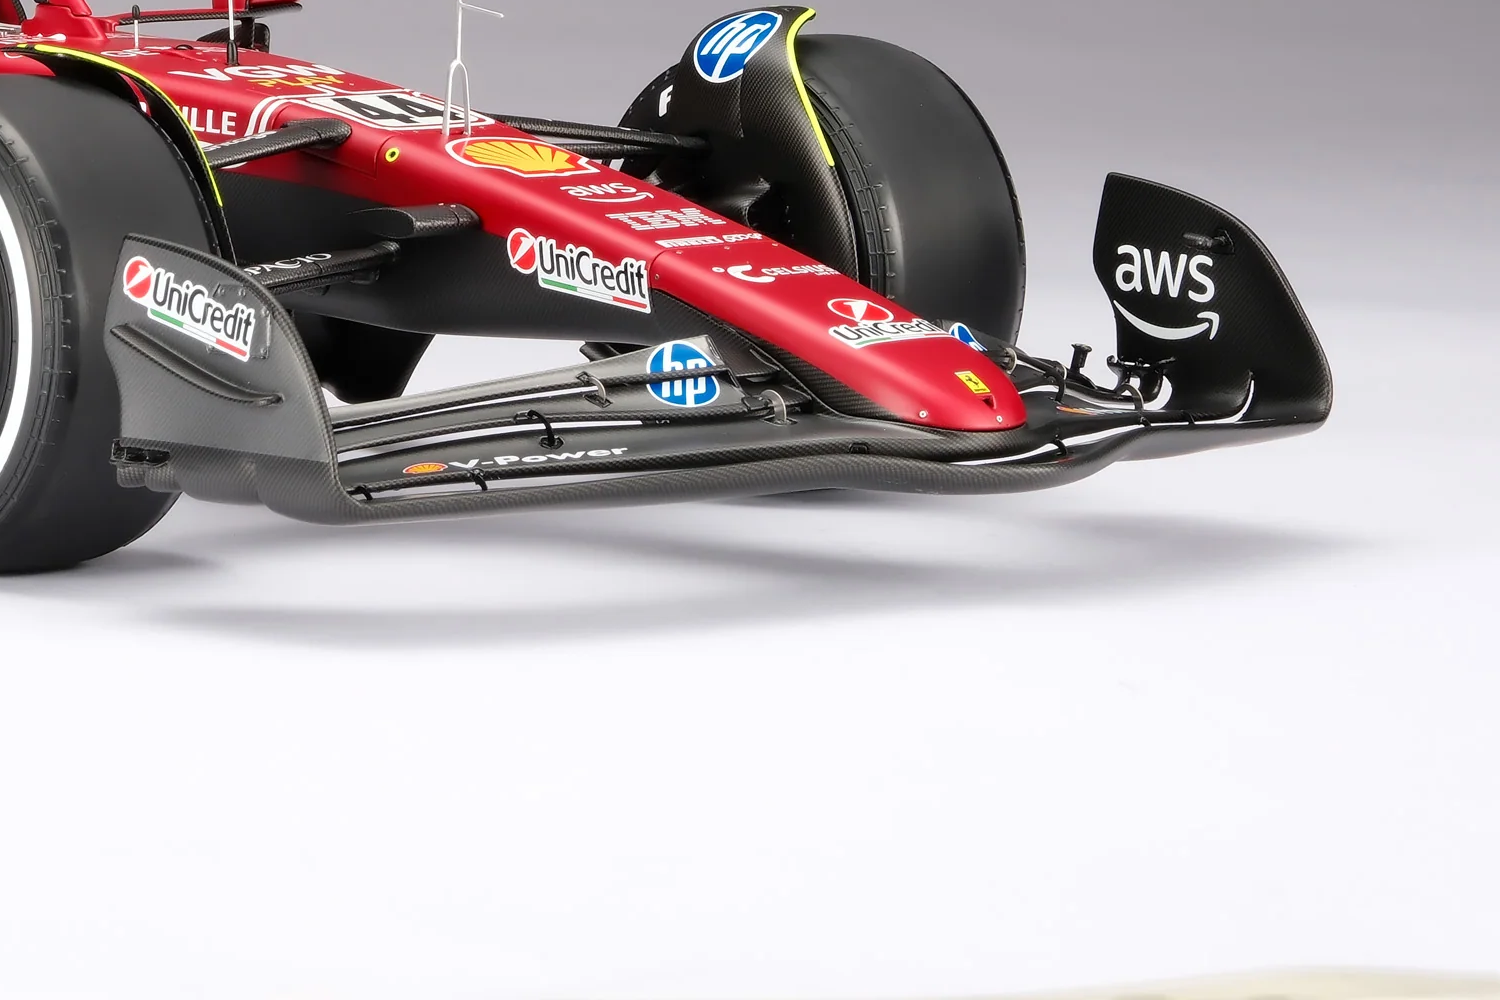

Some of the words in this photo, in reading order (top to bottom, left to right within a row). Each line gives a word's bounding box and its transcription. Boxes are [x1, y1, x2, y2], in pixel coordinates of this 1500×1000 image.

[700, 12, 770, 80] hp
[167, 64, 346, 81] VGW
[176, 105, 237, 136] ILLE
[560, 182, 637, 198] aws
[605, 208, 728, 231] IBM
[537, 240, 650, 300] UniCredit
[1114, 243, 1217, 304] aws
[151, 273, 257, 347] UniCredit
[658, 341, 712, 406] hp
[447, 447, 629, 471] V-Power
